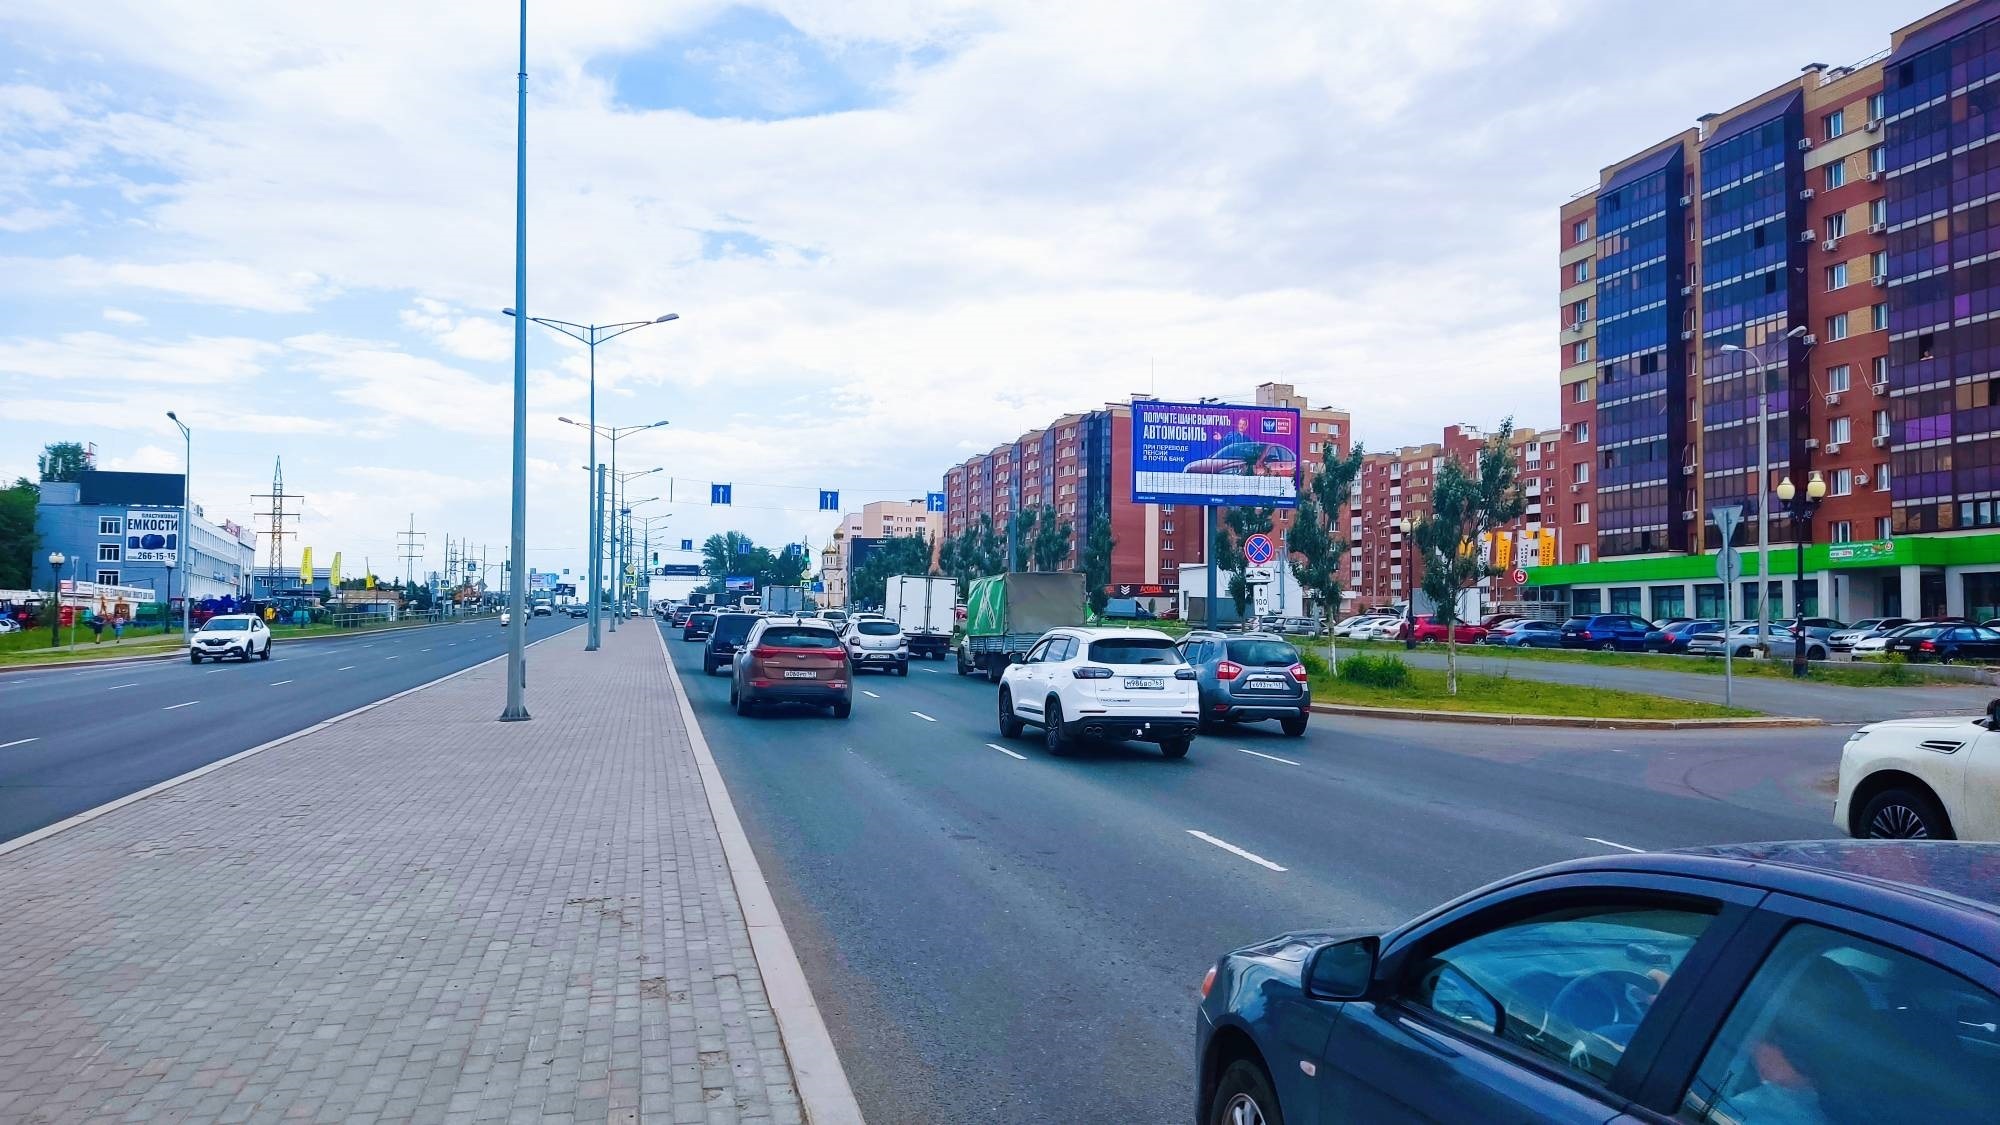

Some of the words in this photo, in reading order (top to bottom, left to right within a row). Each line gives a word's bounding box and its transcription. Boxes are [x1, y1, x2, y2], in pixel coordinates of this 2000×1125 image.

[1143, 411, 1177, 424] ПОЛУЧИТЕ
[1177, 413, 1197, 425] ШАНС
[1197, 414, 1231, 426] ВЫИГРАТЬ
[1143, 424, 1207, 442] АВТОМОБИЛЬ
[128, 518, 178, 530] ЕМКОСТИ
[138, 552, 176, 560] 266-15-15
